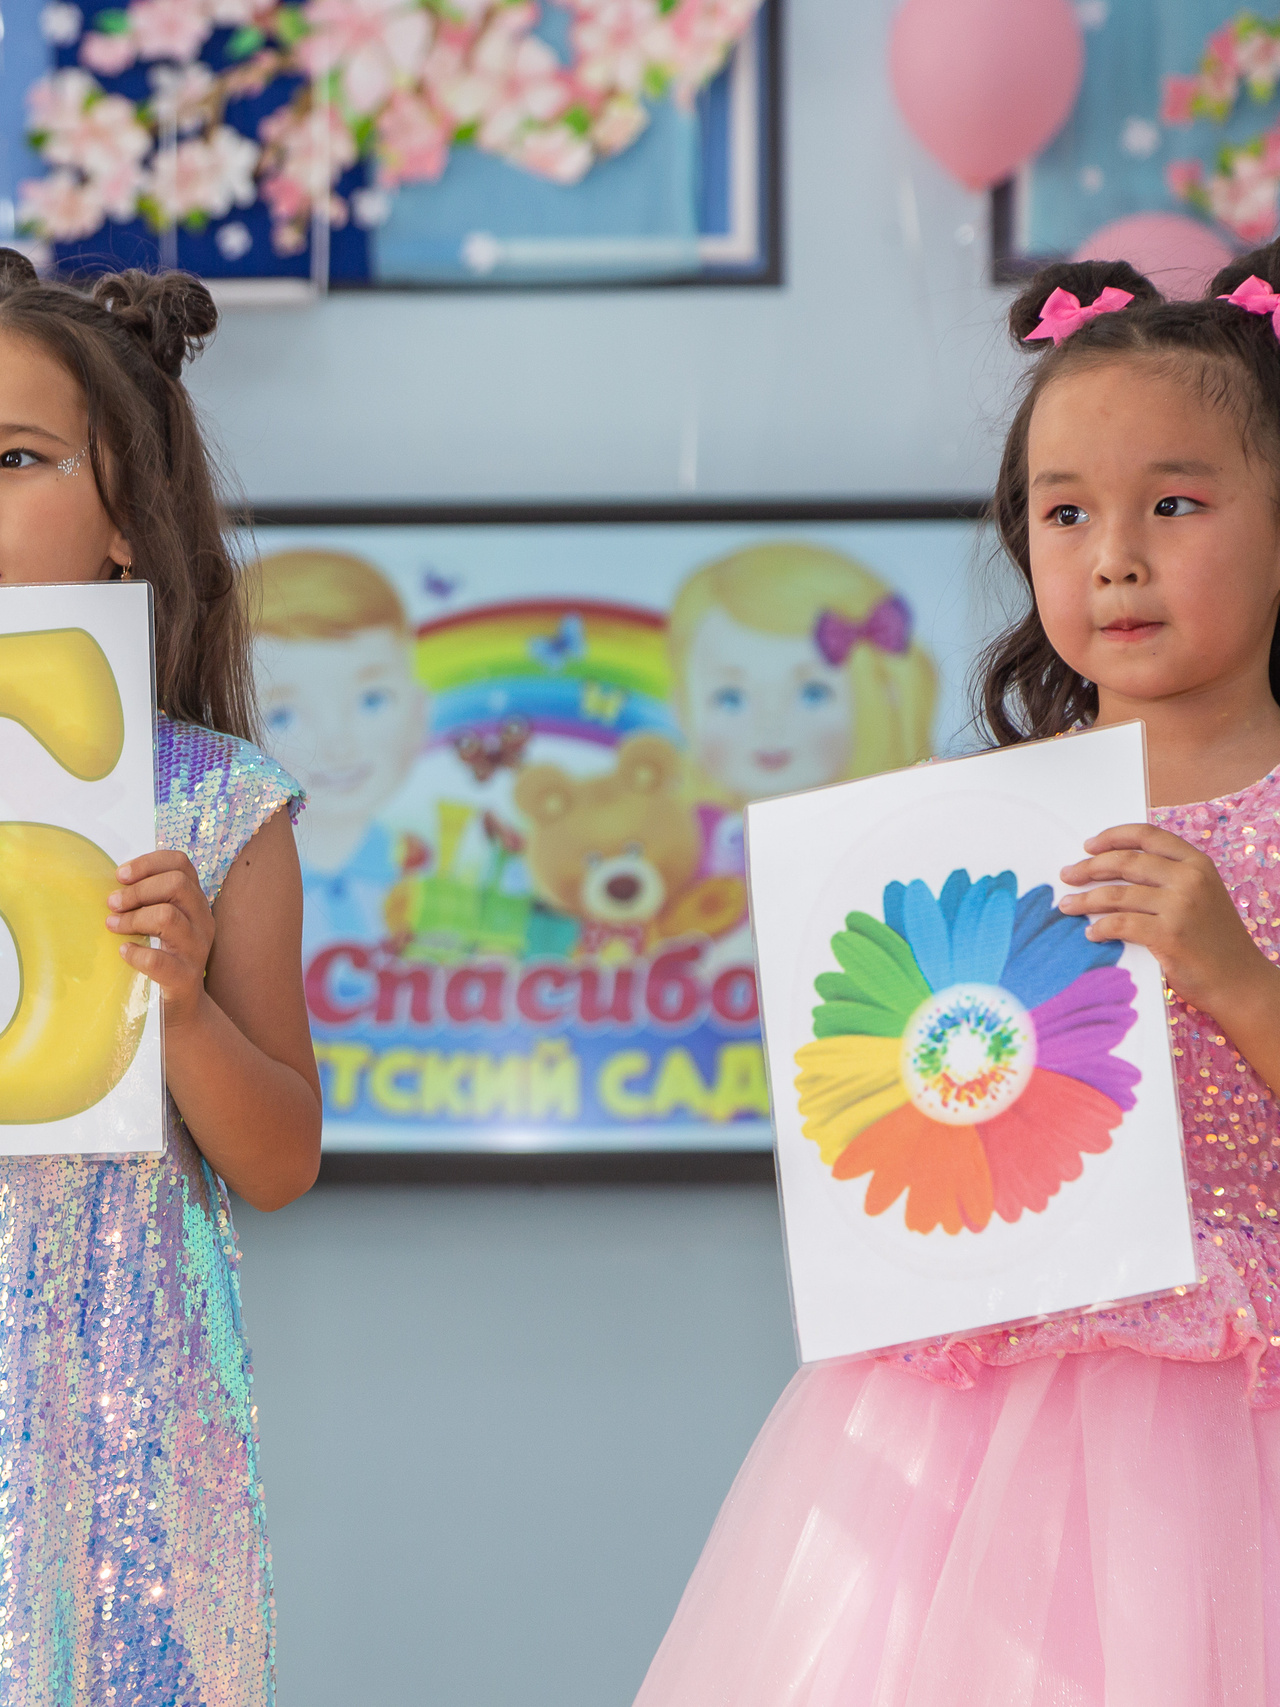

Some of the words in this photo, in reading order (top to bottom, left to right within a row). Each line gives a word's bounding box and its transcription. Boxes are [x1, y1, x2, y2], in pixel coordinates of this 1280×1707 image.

[306, 943, 760, 1024] Спасибо
[314, 1038, 578, 1118] ТСКИЙ
[600, 1044, 770, 1119] САД
